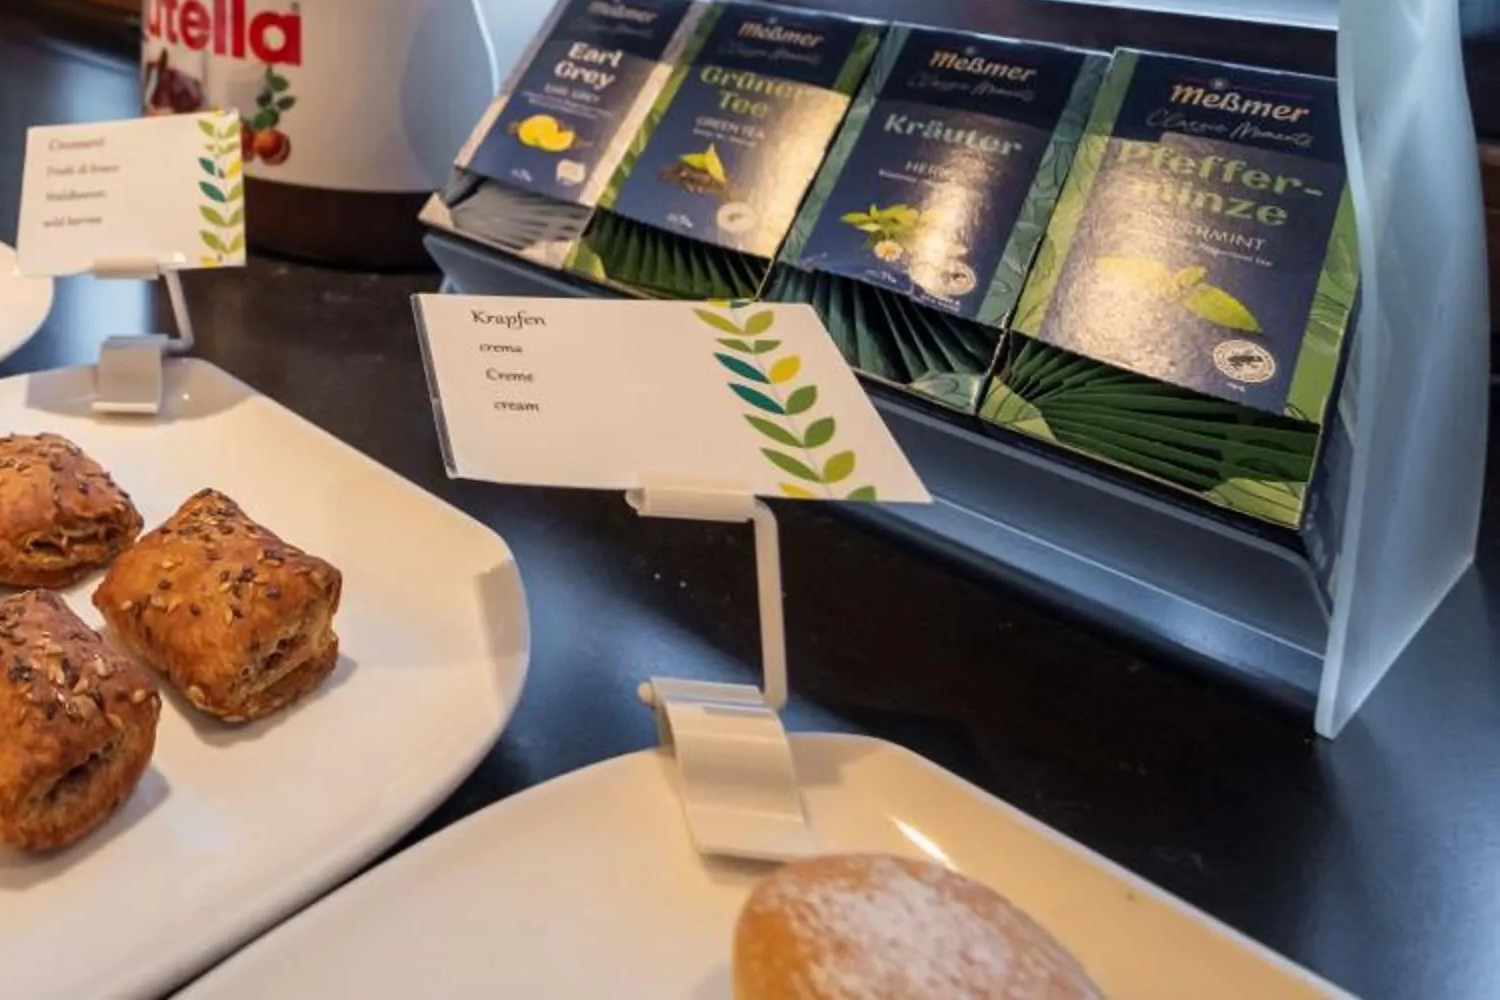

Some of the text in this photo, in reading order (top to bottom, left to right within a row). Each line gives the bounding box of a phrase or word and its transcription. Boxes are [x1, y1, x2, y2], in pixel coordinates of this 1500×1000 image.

[567, 41, 623, 68] Earl
[928, 49, 1038, 82] Meßmer
[553, 60, 615, 91] Grey
[718, 90, 770, 118] Tee
[1169, 83, 1311, 123] Meßmer
[883, 112, 1024, 157] Kräuter
[470, 308, 547, 330] Krapfen
[479, 342, 524, 353] crema
[485, 367, 535, 383] Creme
[493, 400, 540, 413] cream
